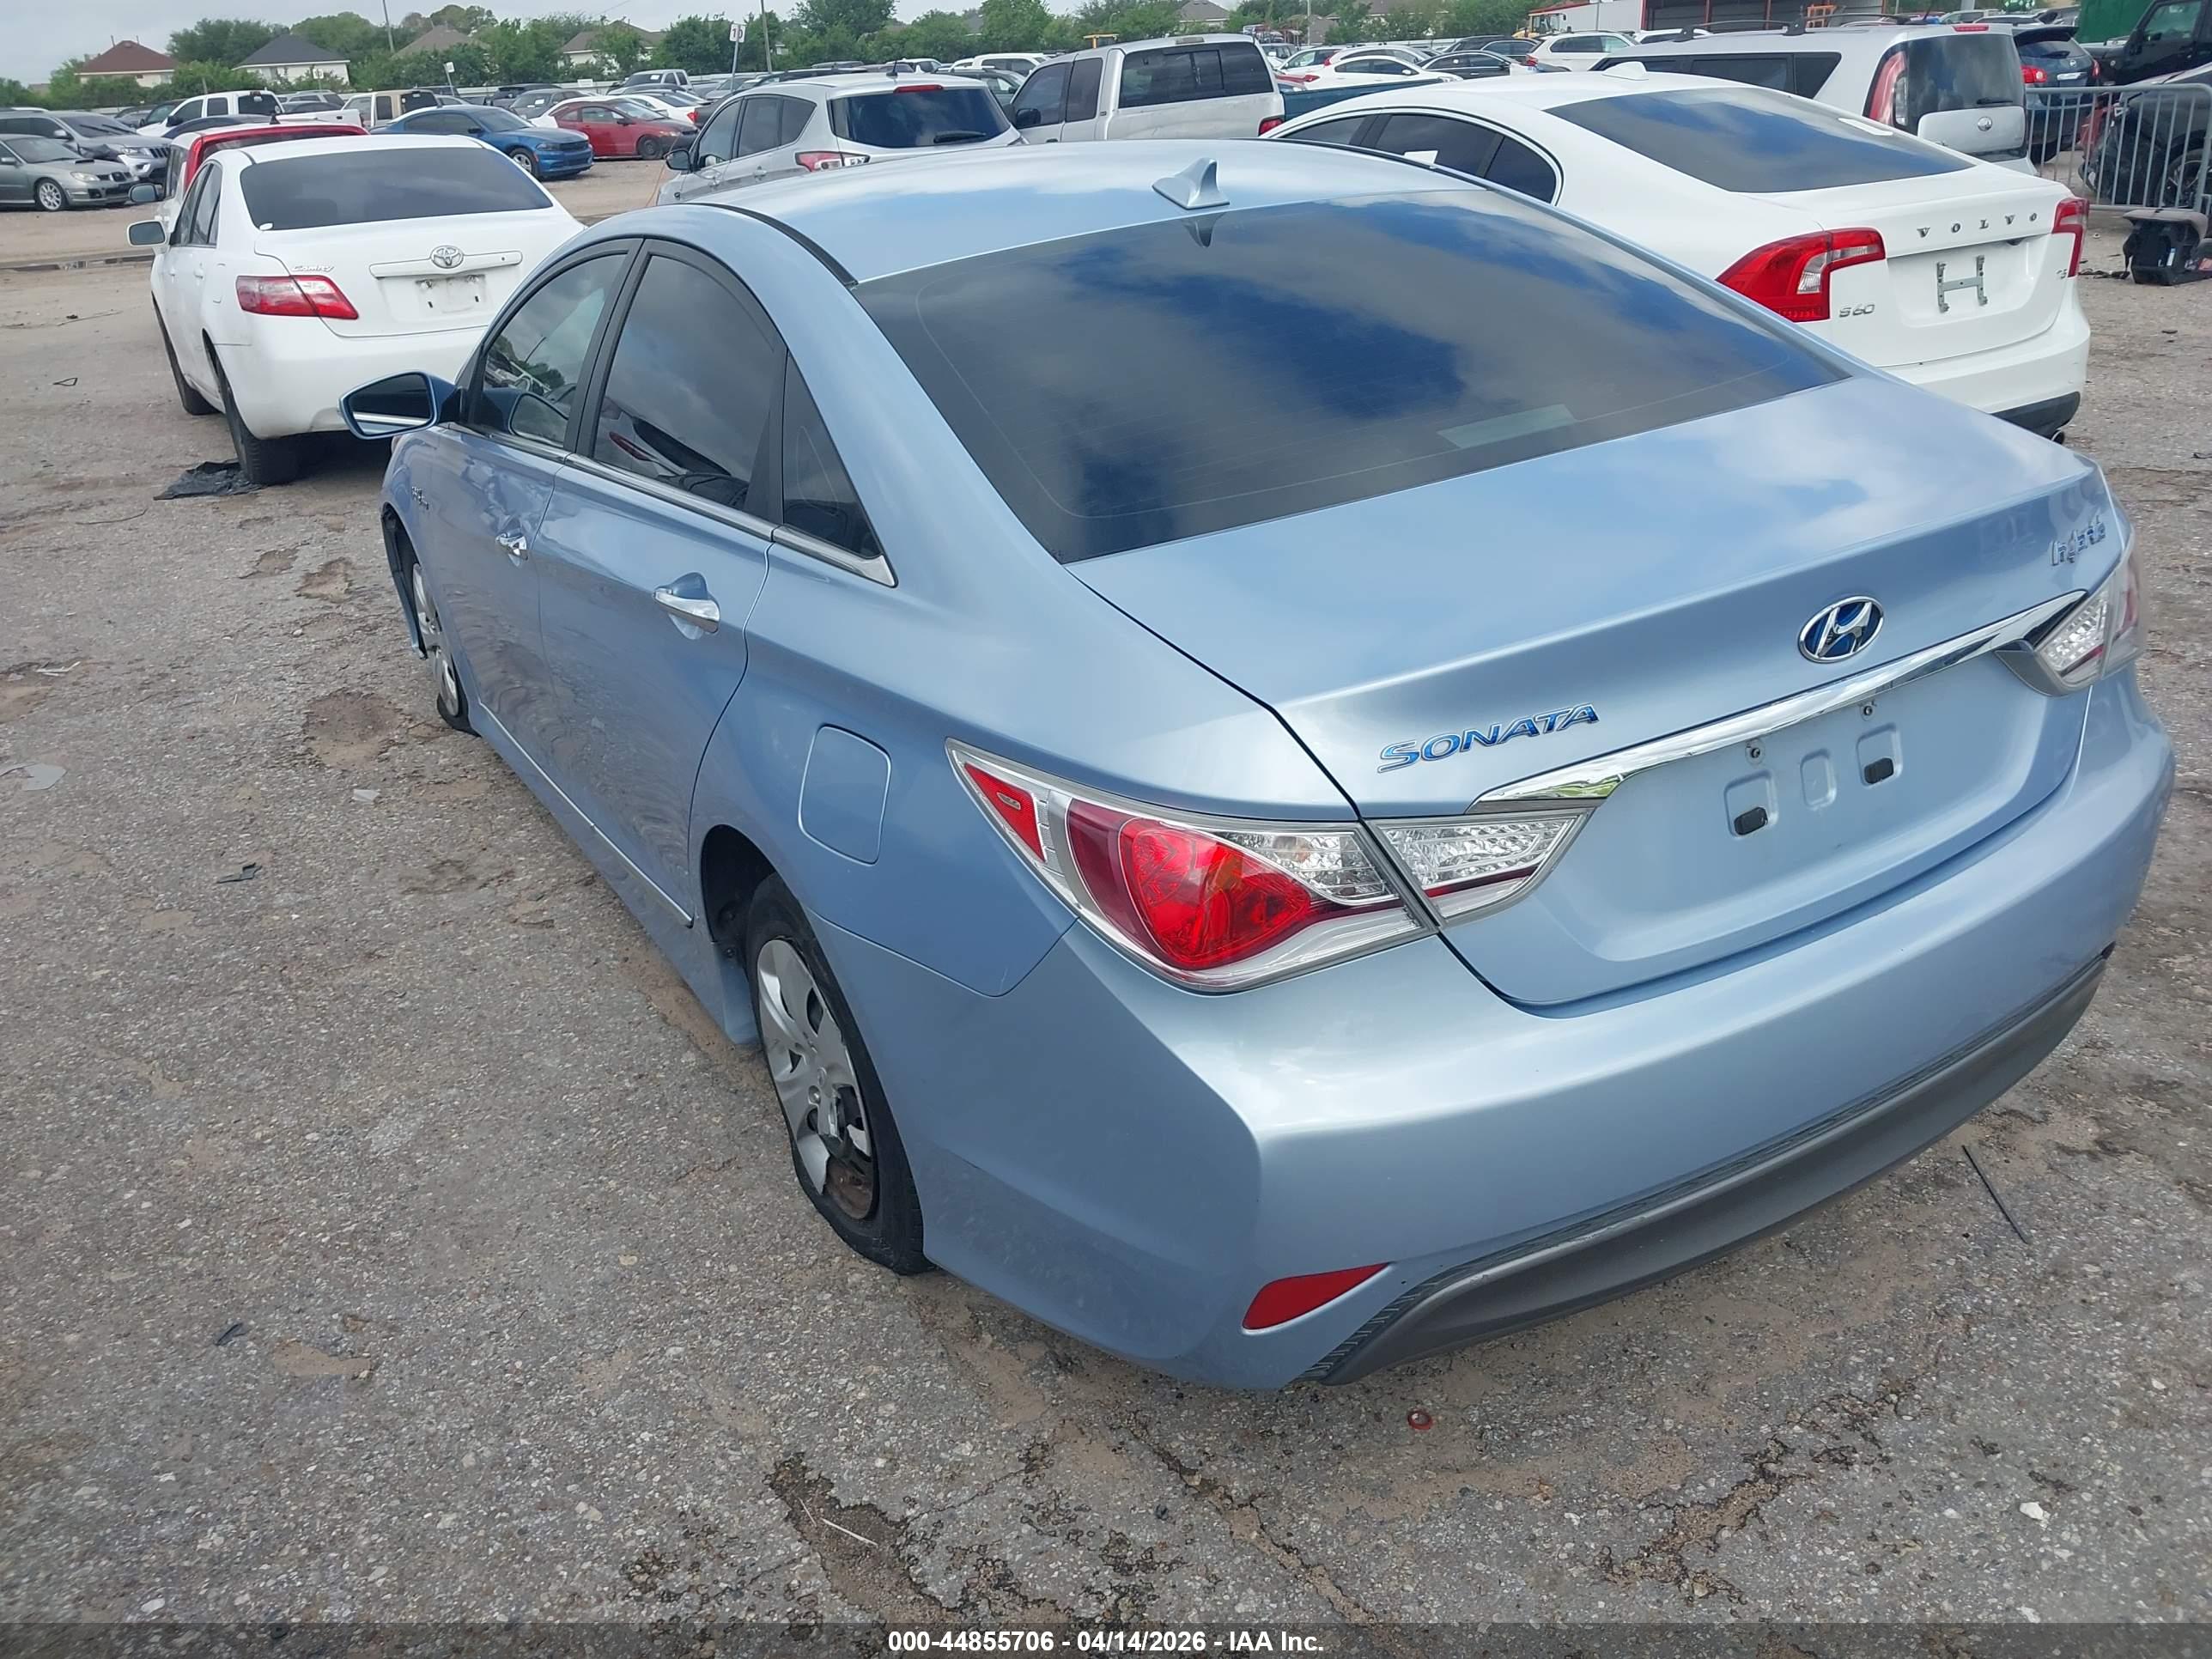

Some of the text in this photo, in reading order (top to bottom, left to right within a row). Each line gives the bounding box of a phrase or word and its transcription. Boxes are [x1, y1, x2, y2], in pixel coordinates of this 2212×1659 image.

[1917, 212, 2038, 238] VOLVO
[1838, 303, 1875, 318] S60
[1376, 702, 1600, 774] SONATA
